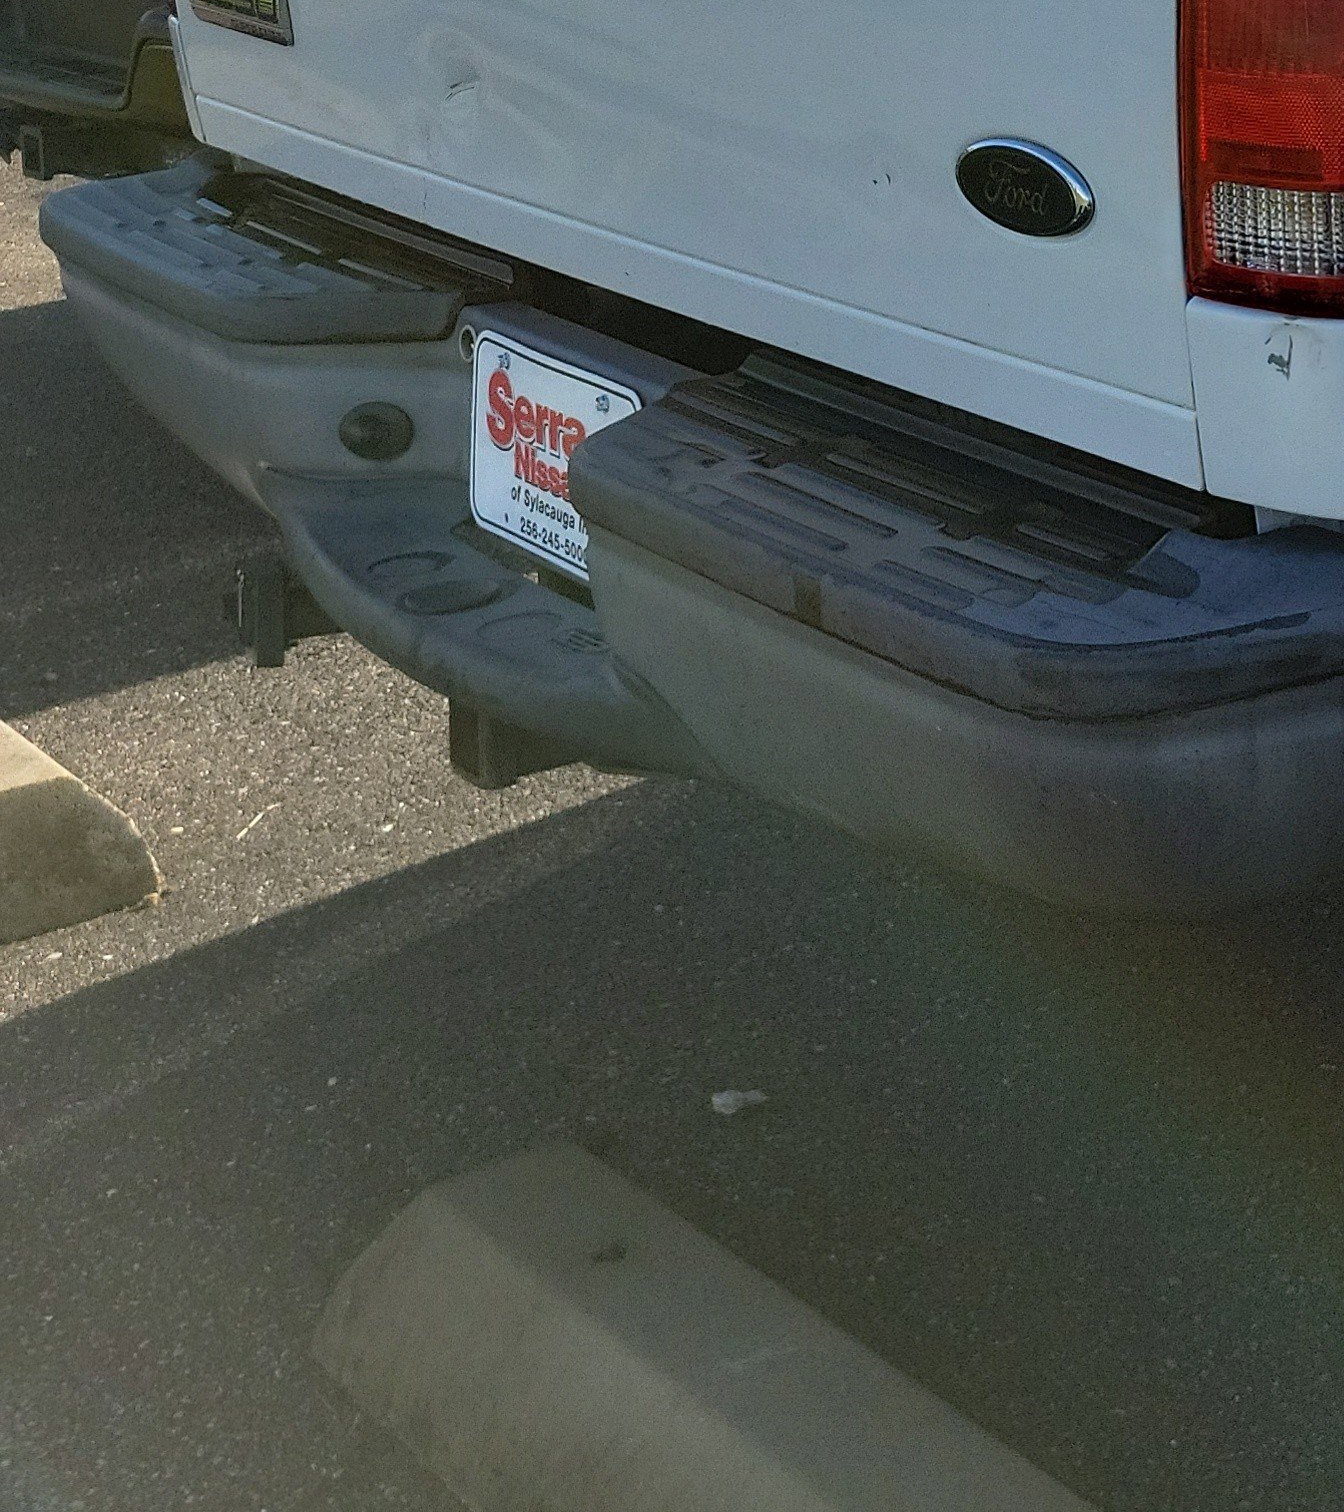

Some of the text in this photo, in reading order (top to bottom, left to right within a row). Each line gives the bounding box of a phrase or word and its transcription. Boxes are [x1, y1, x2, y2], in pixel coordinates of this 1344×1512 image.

[486, 370, 586, 457] Serra
[514, 441, 570, 502] Nissa
[511, 486, 521, 502] of
[524, 489, 575, 530] Sylacauga
[520, 516, 584, 562] 256-245-500
